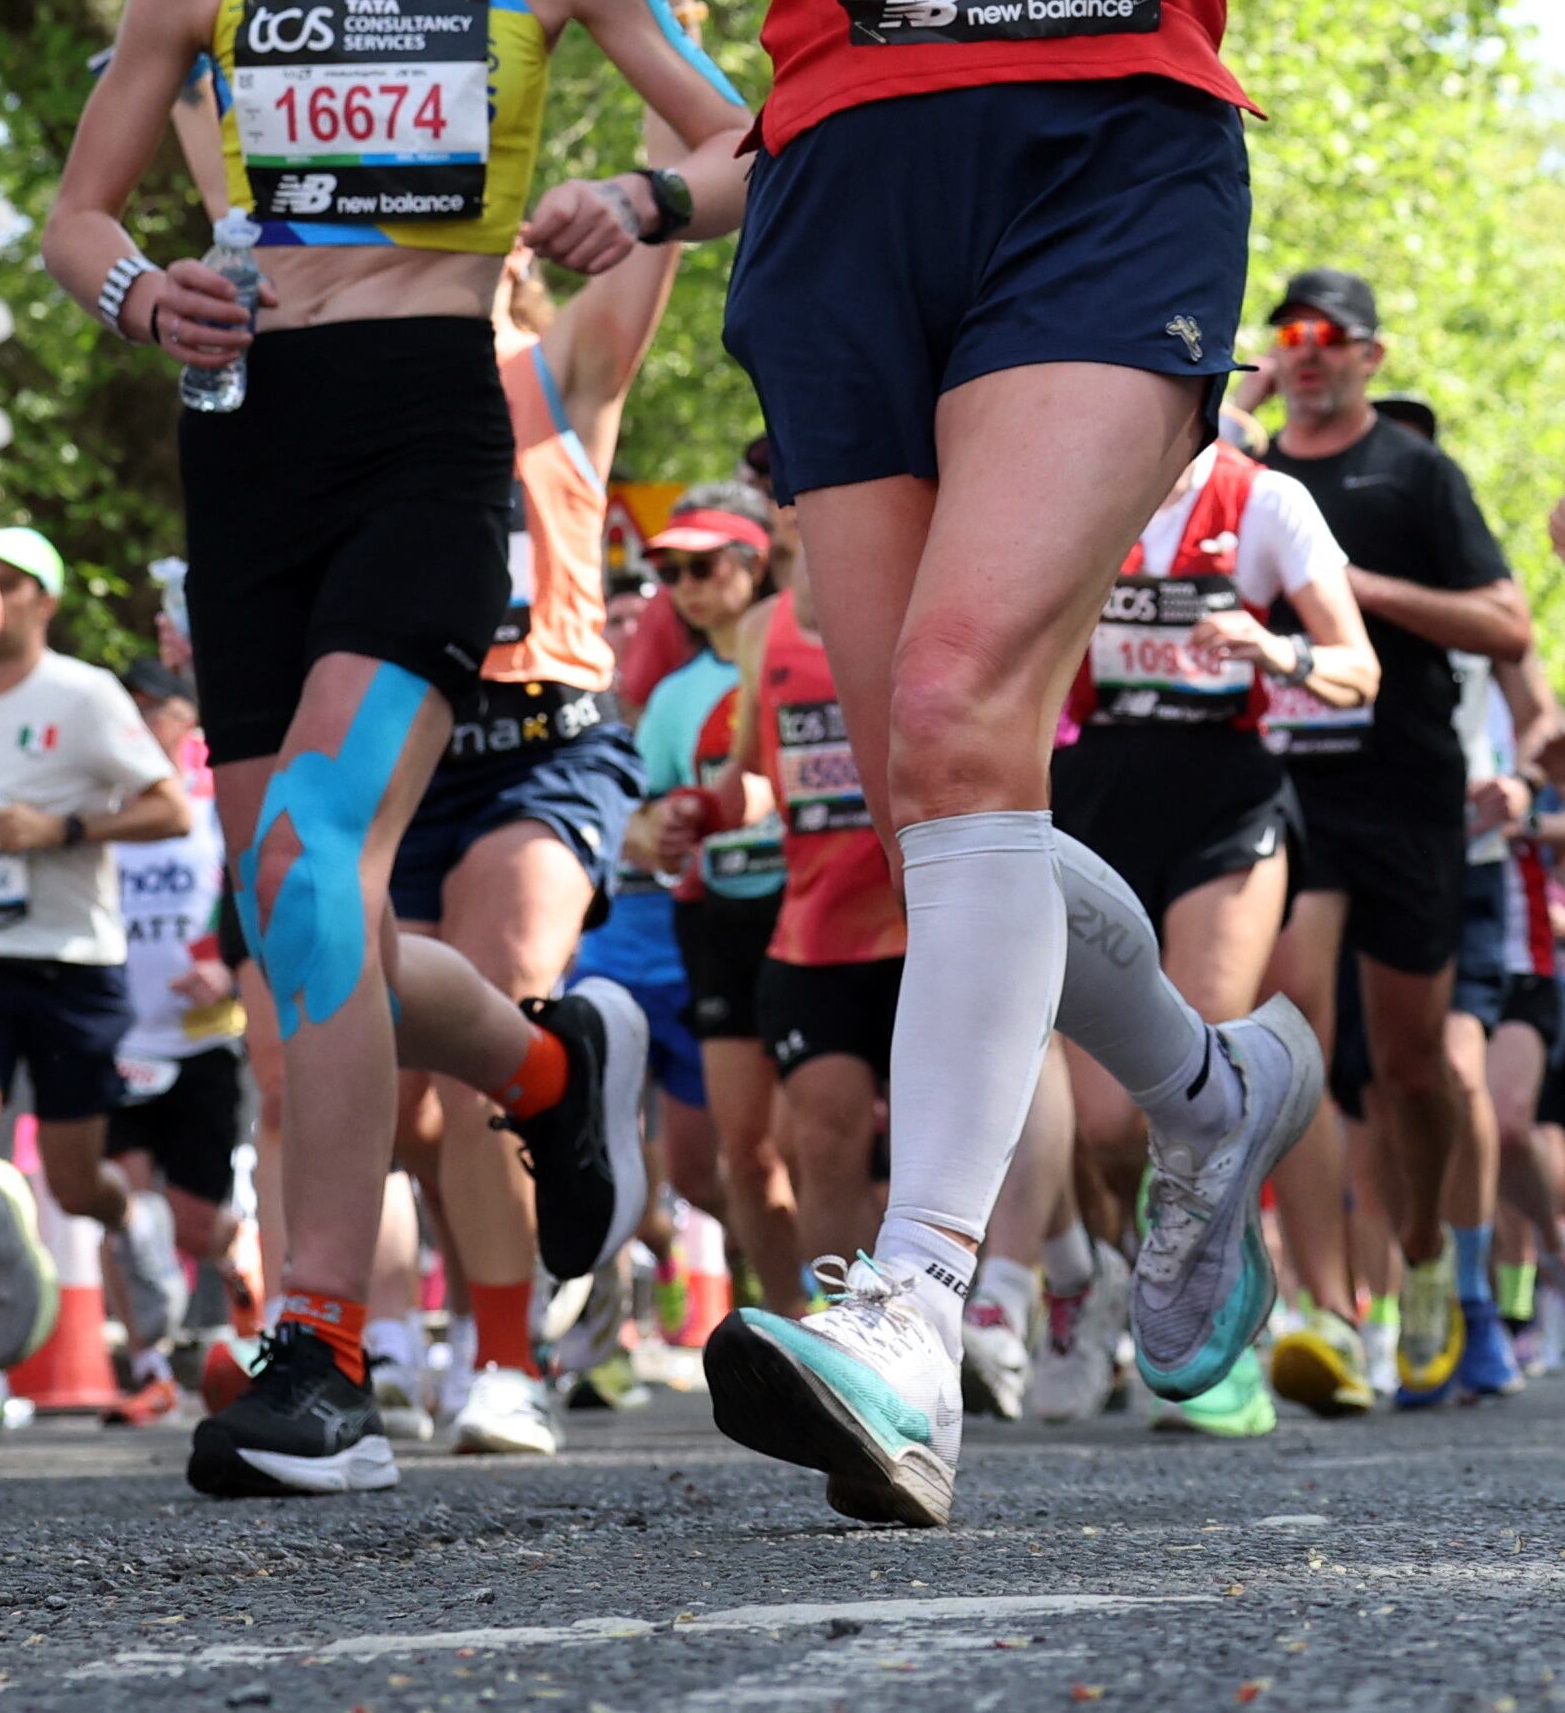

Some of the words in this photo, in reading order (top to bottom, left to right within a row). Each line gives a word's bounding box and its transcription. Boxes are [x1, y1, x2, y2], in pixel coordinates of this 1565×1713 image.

[344, 16, 473, 33] CONSULTANCY
[968, 1, 1023, 26] new
[344, 34, 426, 51] SERVICES
[274, 83, 447, 143] 16674
[337, 195, 377, 213] new
[380, 192, 465, 213] balance
[1067, 898, 1145, 970] 2XU
